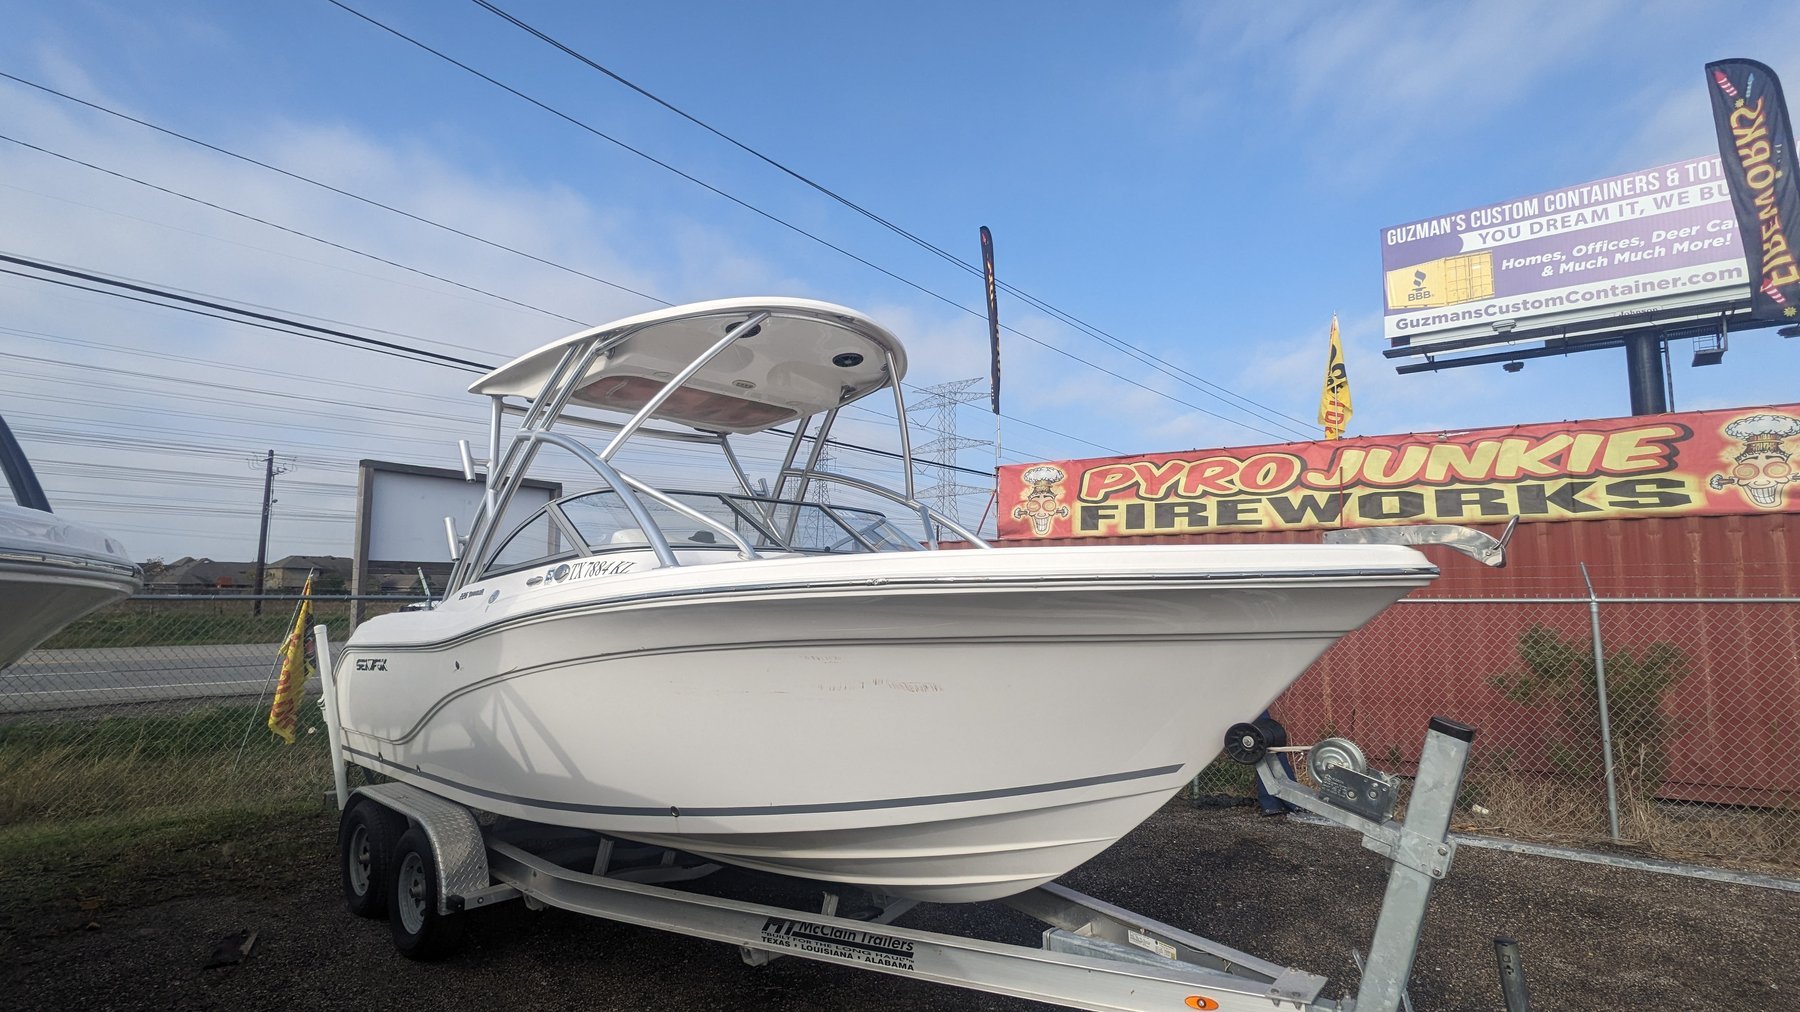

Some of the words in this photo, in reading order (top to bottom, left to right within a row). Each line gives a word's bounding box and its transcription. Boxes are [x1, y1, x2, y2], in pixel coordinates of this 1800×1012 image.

[1387, 214, 1466, 246] GUZMAN'S
[1470, 198, 1539, 228] CUSTOM
[1544, 171, 1660, 213] CONTAINERS
[1666, 168, 1680, 187] &
[1478, 225, 1521, 245] YOU
[1529, 207, 1610, 235] DREAM
[1618, 200, 1645, 218] IT,
[1652, 190, 1690, 210] WE
[1501, 250, 1566, 271] Homes,
[1572, 236, 1645, 257] Offices,
[1651, 225, 1700, 243] Deer
[1706, 218, 1739, 233] Ca
[1541, 265, 1554, 278] &
[1559, 254, 1609, 274] Much
[1613, 245, 1666, 265] Much
[1672, 232, 1732, 255] More!
[1395, 266, 1743, 331] GuzmansCustomContainer.com
[1407, 290, 1432, 302] BBB
[1078, 452, 1304, 502] PYRO
[1303, 425, 1685, 488] JUNKIE
[1081, 478, 1692, 531] FIREWORKS
[569, 561, 588, 581] TX
[761, 935, 791, 948] TEXAS
[801, 943, 854, 960] LOUISIANA
[864, 956, 915, 971] ALABAMA
[799, 921, 857, 941] McClain
[861, 932, 915, 952] Trailers
[815, 941, 832, 949] THE
[835, 945, 872, 956] LONG
